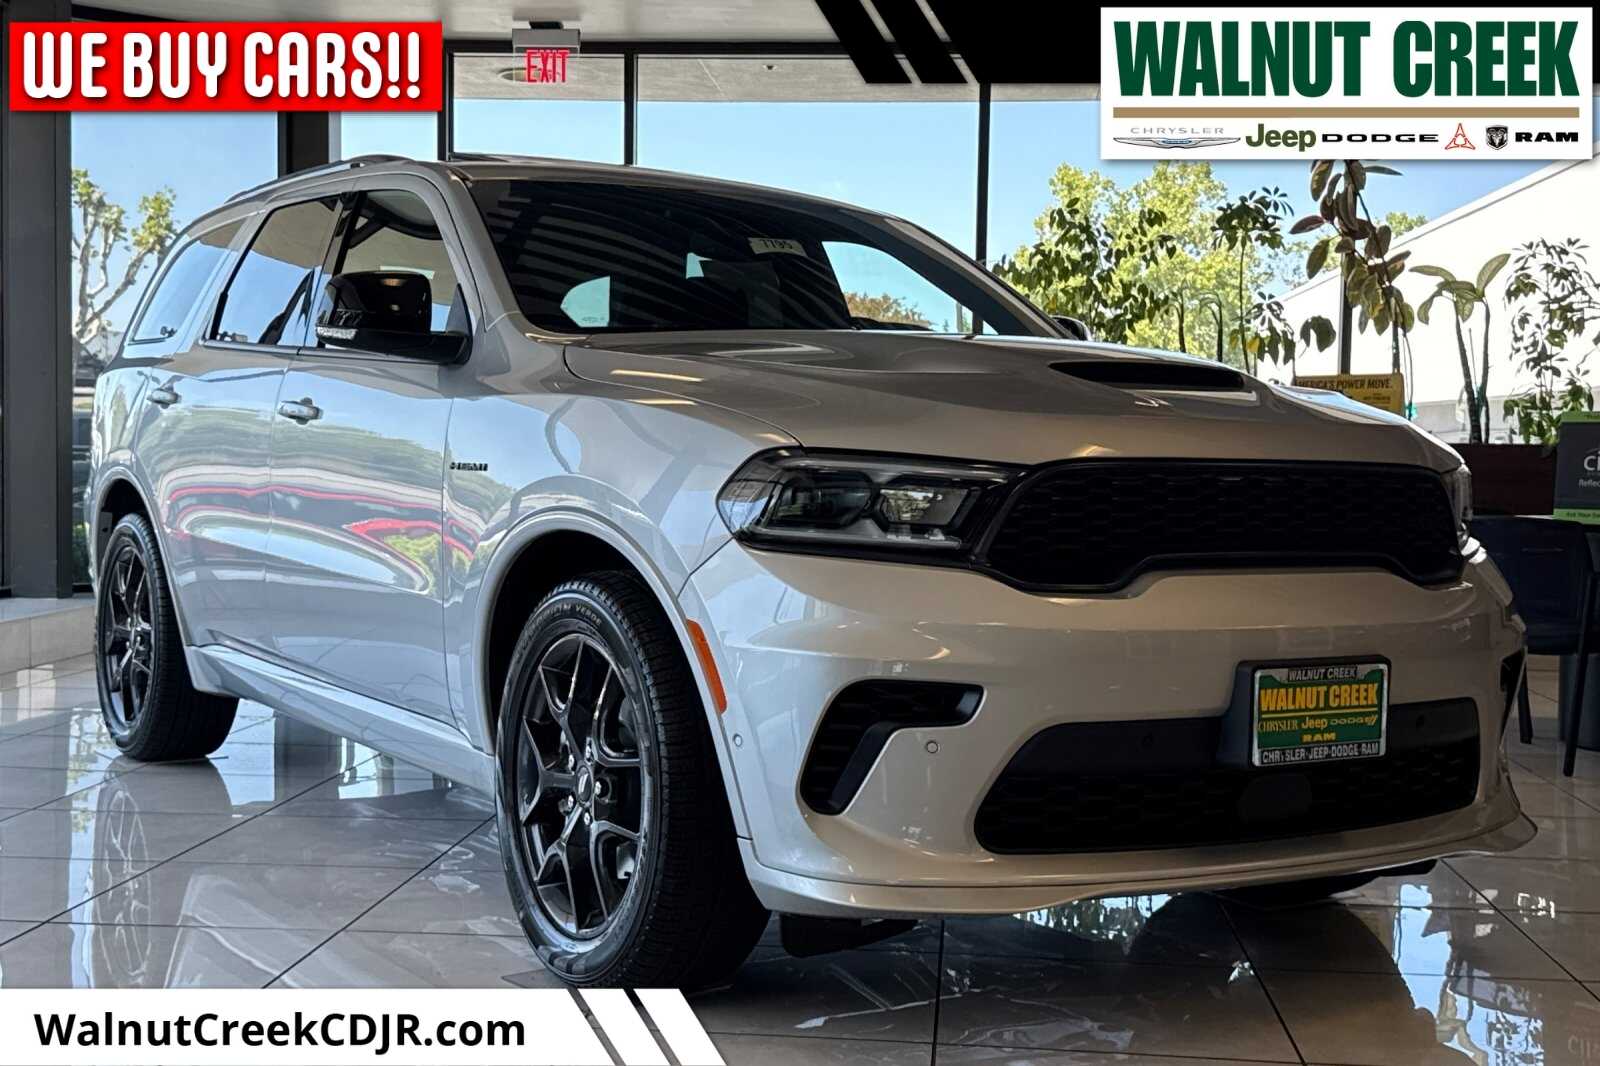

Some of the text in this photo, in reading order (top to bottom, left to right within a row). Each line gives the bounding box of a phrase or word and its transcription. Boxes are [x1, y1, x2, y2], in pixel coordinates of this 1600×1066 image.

[527, 49, 570, 83] EXIT
[1295, 379, 1336, 390] MERICA'S
[1336, 378, 1366, 390] POWER
[1289, 667, 1356, 681] WALNUT CREEK
[1260, 683, 1378, 711] WALNUT CREEK
[1258, 720, 1298, 732] CHRYSLER
[1301, 716, 1328, 729] Jeep
[1302, 732, 1337, 743] RAM
